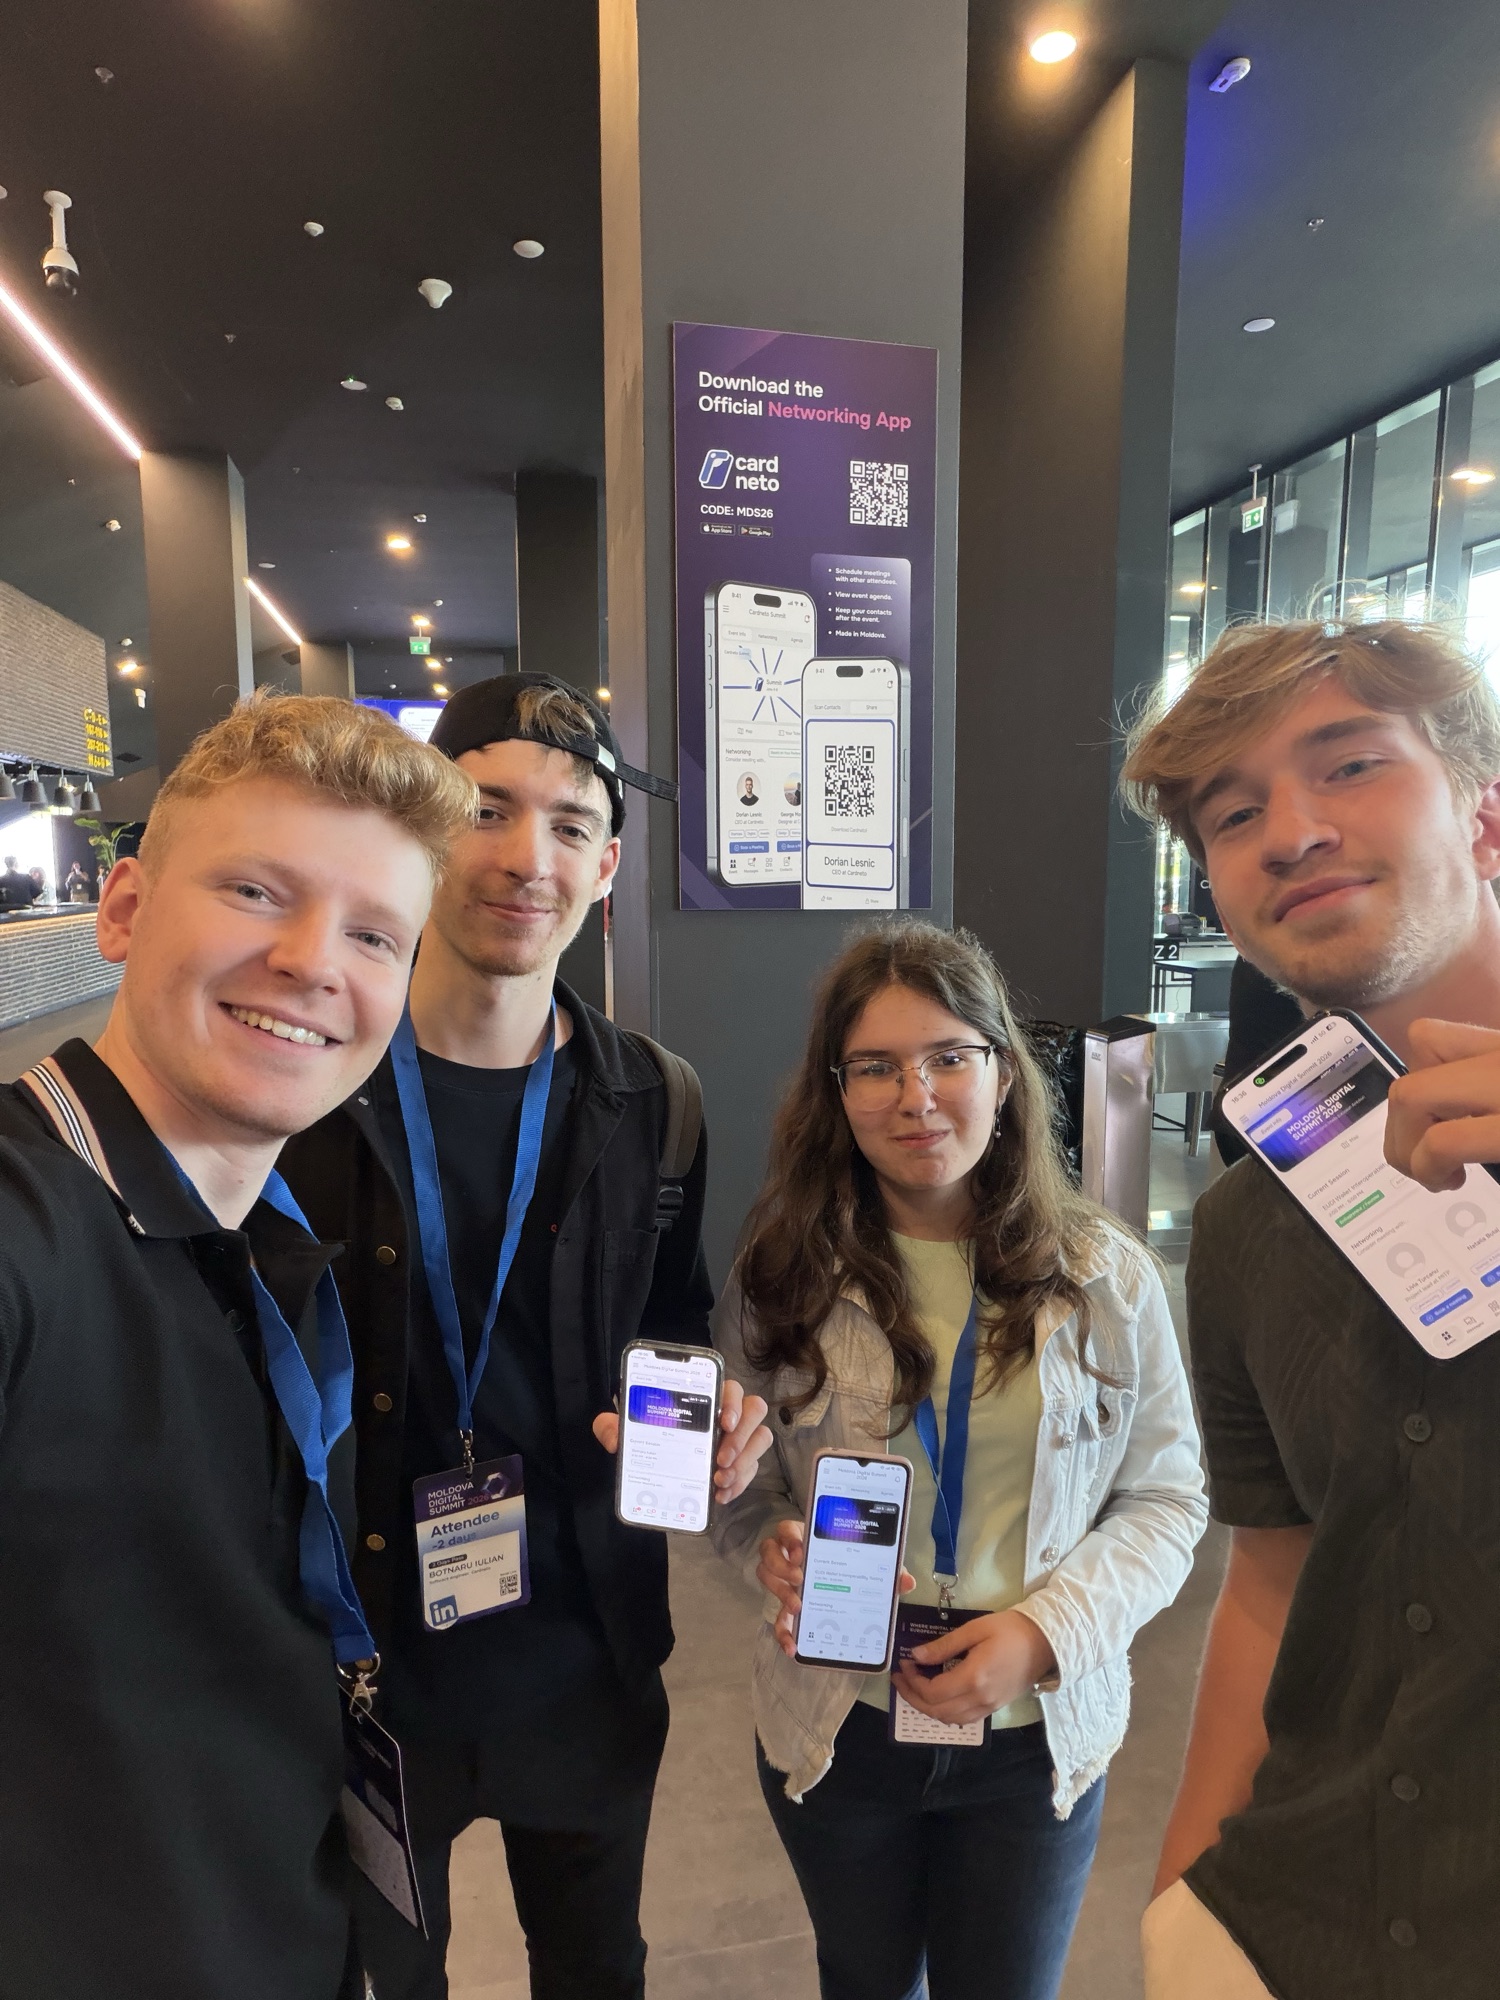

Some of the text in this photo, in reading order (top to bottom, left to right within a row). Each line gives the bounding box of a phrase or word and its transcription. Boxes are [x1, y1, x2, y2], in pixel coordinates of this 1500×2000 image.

[698, 371, 824, 398] Download the
[698, 395, 912, 432] Official Networking App
[735, 456, 779, 473] card
[735, 474, 780, 492] neto
[700, 504, 774, 519] CODE: MDS26
[863, 570, 891, 578] meetings
[860, 631, 887, 639] Moldova.
[824, 856, 876, 868] Dorian Lesnic
[1258, 1089, 1281, 1108] Moldova
[1279, 1076, 1299, 1092] Digital
[1296, 1062, 1318, 1079] Summit
[1316, 1050, 1332, 1063] 2026
[1286, 1102, 1326, 1136] MOLDOVA
[1324, 1080, 1356, 1107] DIGITAL
[1292, 1101, 1343, 1141] SUMMIT 2026
[1307, 1166, 1350, 1200] Current Session
[1350, 1223, 1383, 1253] Networking
[647, 1404, 672, 1412] MOLDOVA
[427, 1482, 473, 1498] MOLDOVA
[428, 1493, 463, 1507] DIGITAL
[429, 1494, 488, 1514] SUMMIT 2026
[430, 1510, 499, 1536] Attendee
[448, 1531, 476, 1545] days
[429, 1554, 503, 1578] BOTNARU IULIAN
